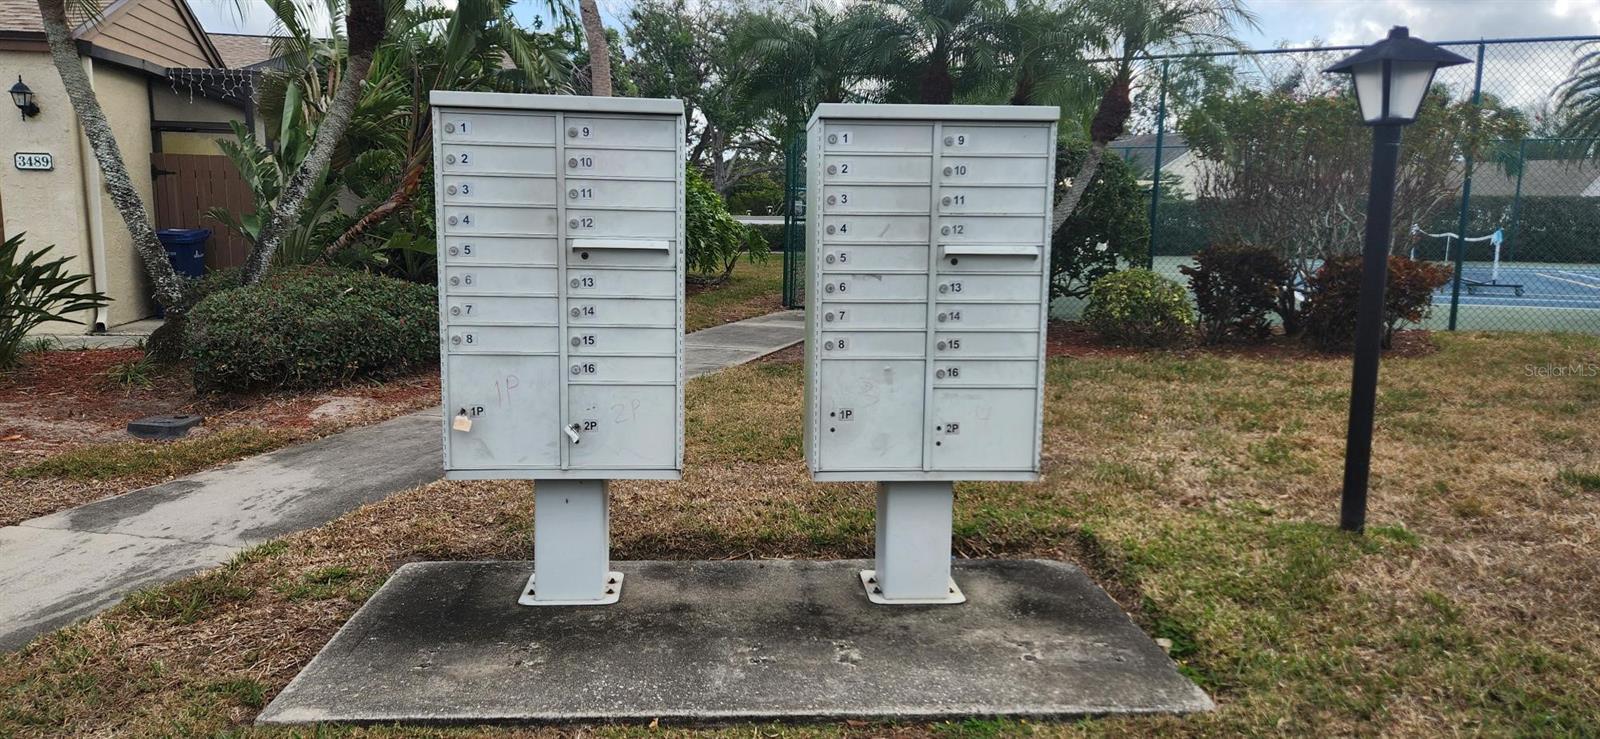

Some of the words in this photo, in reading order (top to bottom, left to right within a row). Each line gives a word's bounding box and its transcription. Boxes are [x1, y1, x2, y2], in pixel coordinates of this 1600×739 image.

[460, 122, 466, 133] 1
[582, 126, 590, 137] 9
[842, 133, 848, 143] 1
[958, 135, 965, 146] 9
[18, 156, 49, 167] 3489
[461, 153, 468, 164] 2
[579, 157, 593, 168] 10
[841, 163, 848, 174] 2
[954, 165, 967, 176] 10
[462, 184, 470, 195] 3
[580, 188, 592, 198] 11
[841, 194, 848, 204] 3
[953, 195, 965, 205] 11
[462, 215, 470, 225] 4
[580, 217, 593, 228] 12
[840, 223, 847, 233] 4
[952, 224, 964, 235] 12
[464, 245, 471, 255] 5
[840, 252, 847, 263] 5
[464, 274, 472, 285] 6
[581, 277, 594, 288] 13
[839, 282, 846, 292] 6
[950, 282, 962, 293] 13
[465, 304, 473, 315] 7
[582, 306, 595, 316] 14
[839, 311, 846, 320] 7
[948, 311, 961, 321] 14
[466, 334, 473, 344] 8
[582, 335, 595, 345] 15
[838, 339, 845, 349] 8
[948, 339, 960, 350] 15
[583, 363, 595, 374] 16
[947, 367, 959, 377] 16
[471, 406, 484, 416] 1P
[839, 409, 853, 420] 1P
[584, 421, 598, 431] 2P
[946, 423, 959, 434] 2P
